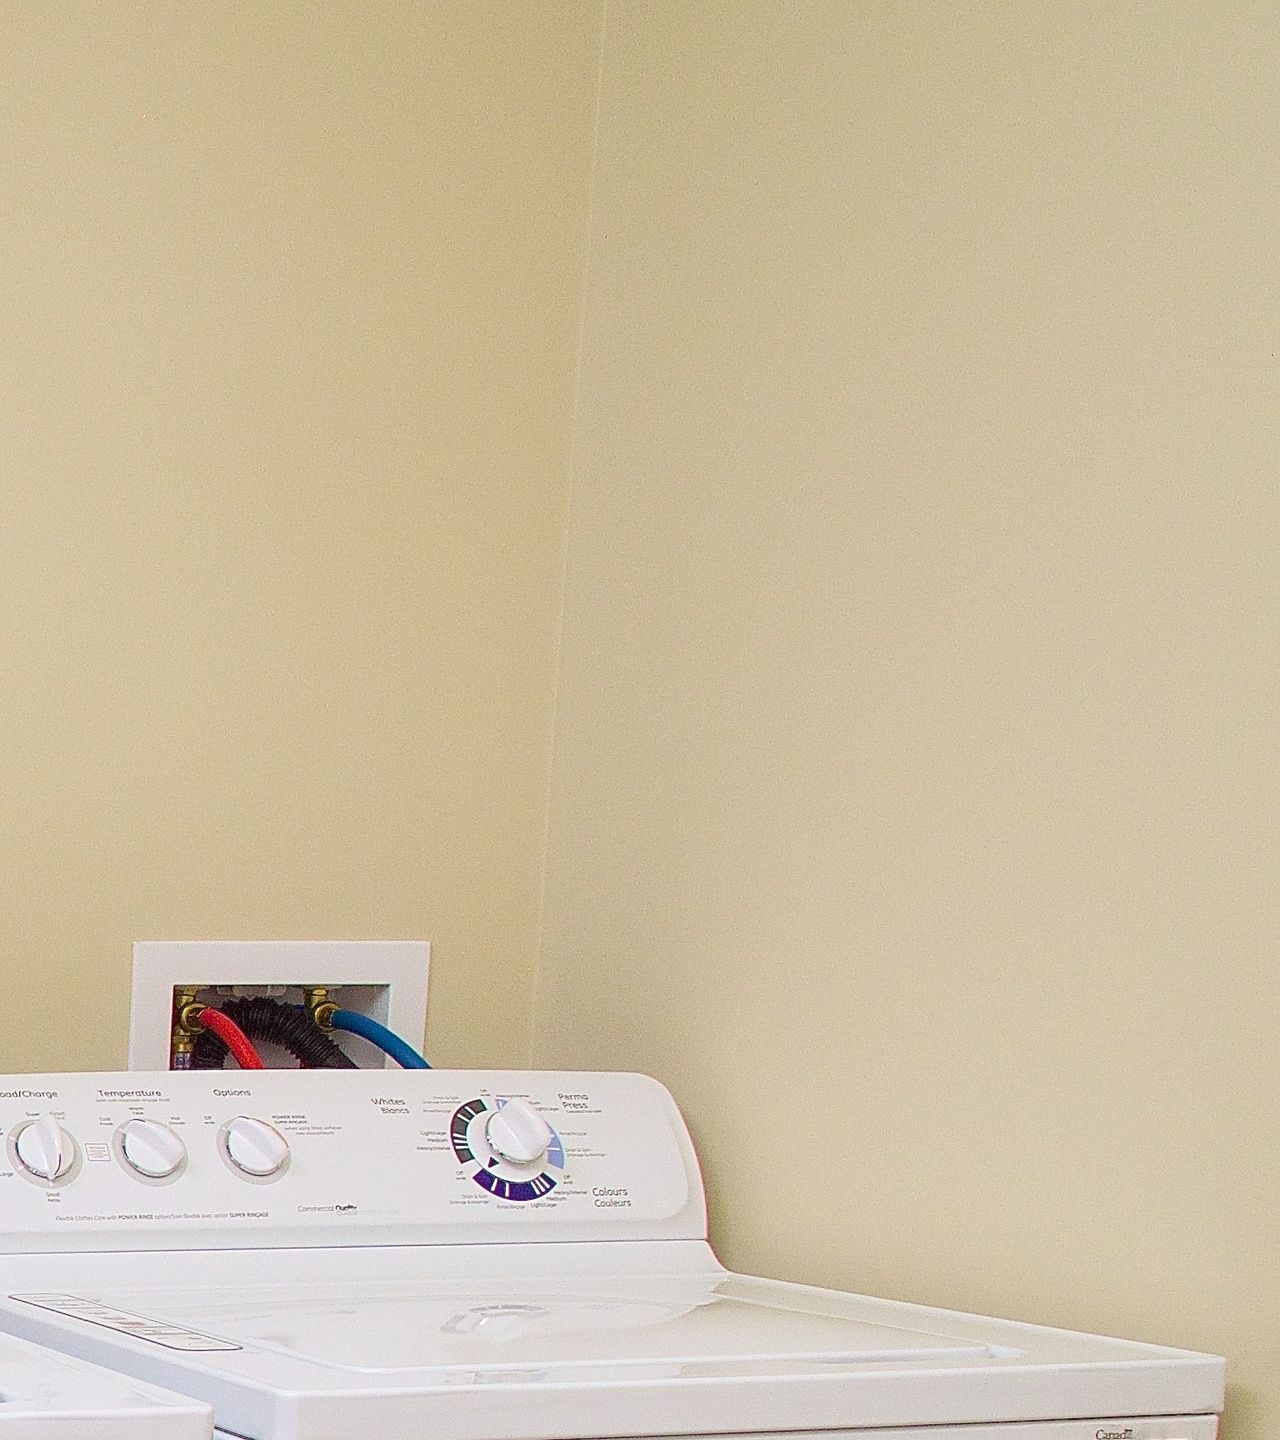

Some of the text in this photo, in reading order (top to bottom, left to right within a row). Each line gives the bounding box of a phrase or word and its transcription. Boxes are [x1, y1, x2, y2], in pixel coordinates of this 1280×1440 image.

[97, 1089, 162, 1098] Temperature
[213, 1089, 251, 1097] Options
[557, 1093, 589, 1101] Perma
[370, 1098, 406, 1106] Whites
[562, 1101, 589, 1109] Press
[592, 1187, 628, 1197] Colours
[594, 1199, 632, 1208] Couleurs
